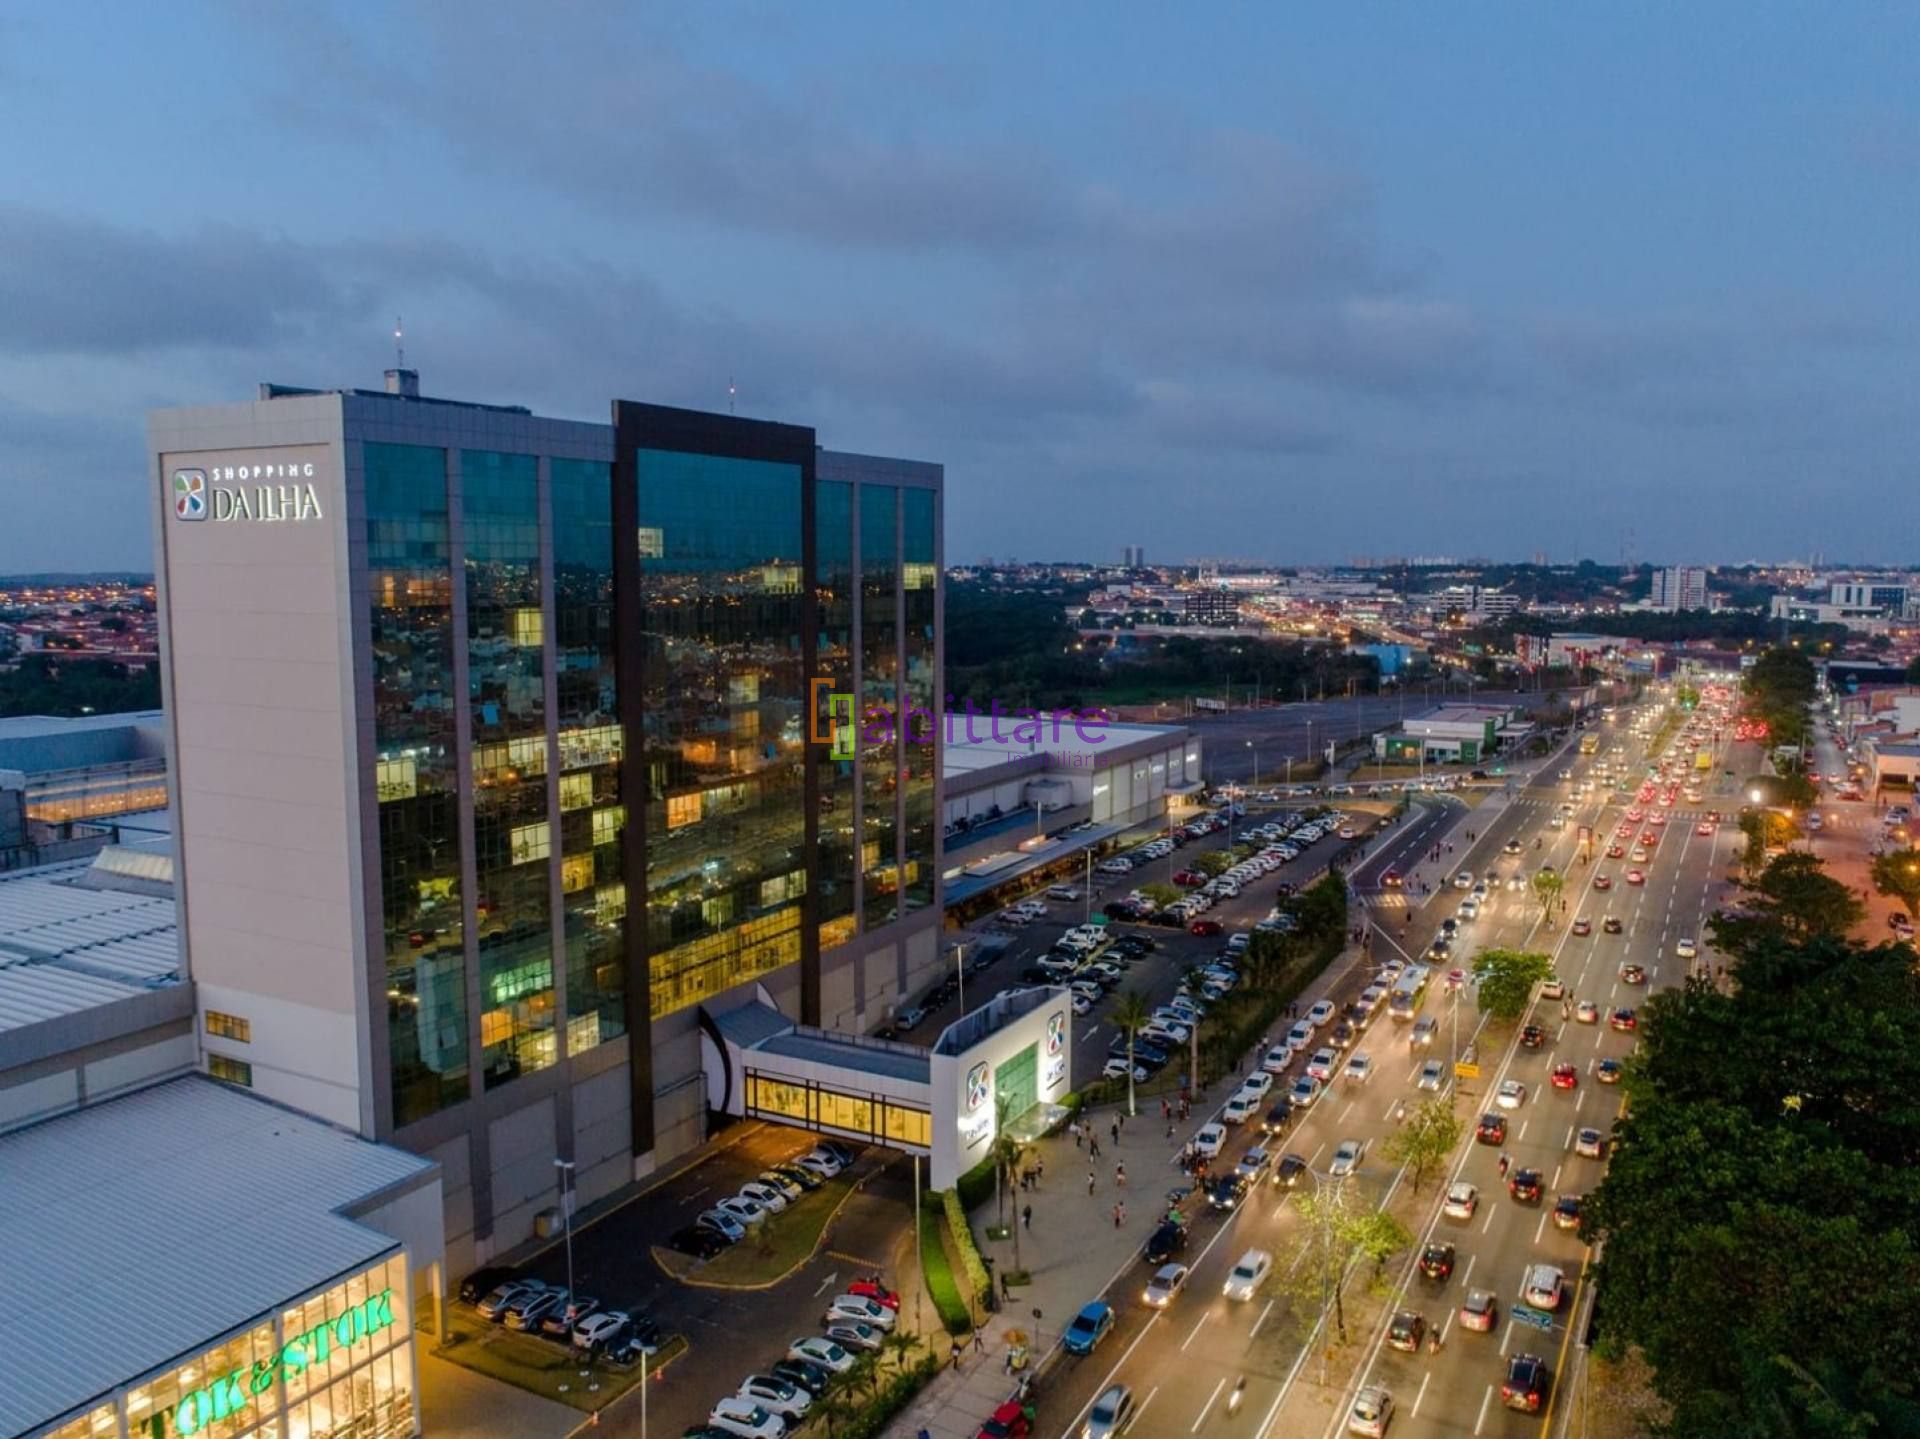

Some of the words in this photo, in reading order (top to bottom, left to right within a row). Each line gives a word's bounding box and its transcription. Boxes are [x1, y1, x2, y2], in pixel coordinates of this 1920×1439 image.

[212, 463, 313, 482] SHOPPING
[250, 1356, 281, 1395] &
[280, 1287, 397, 1384] STOK
